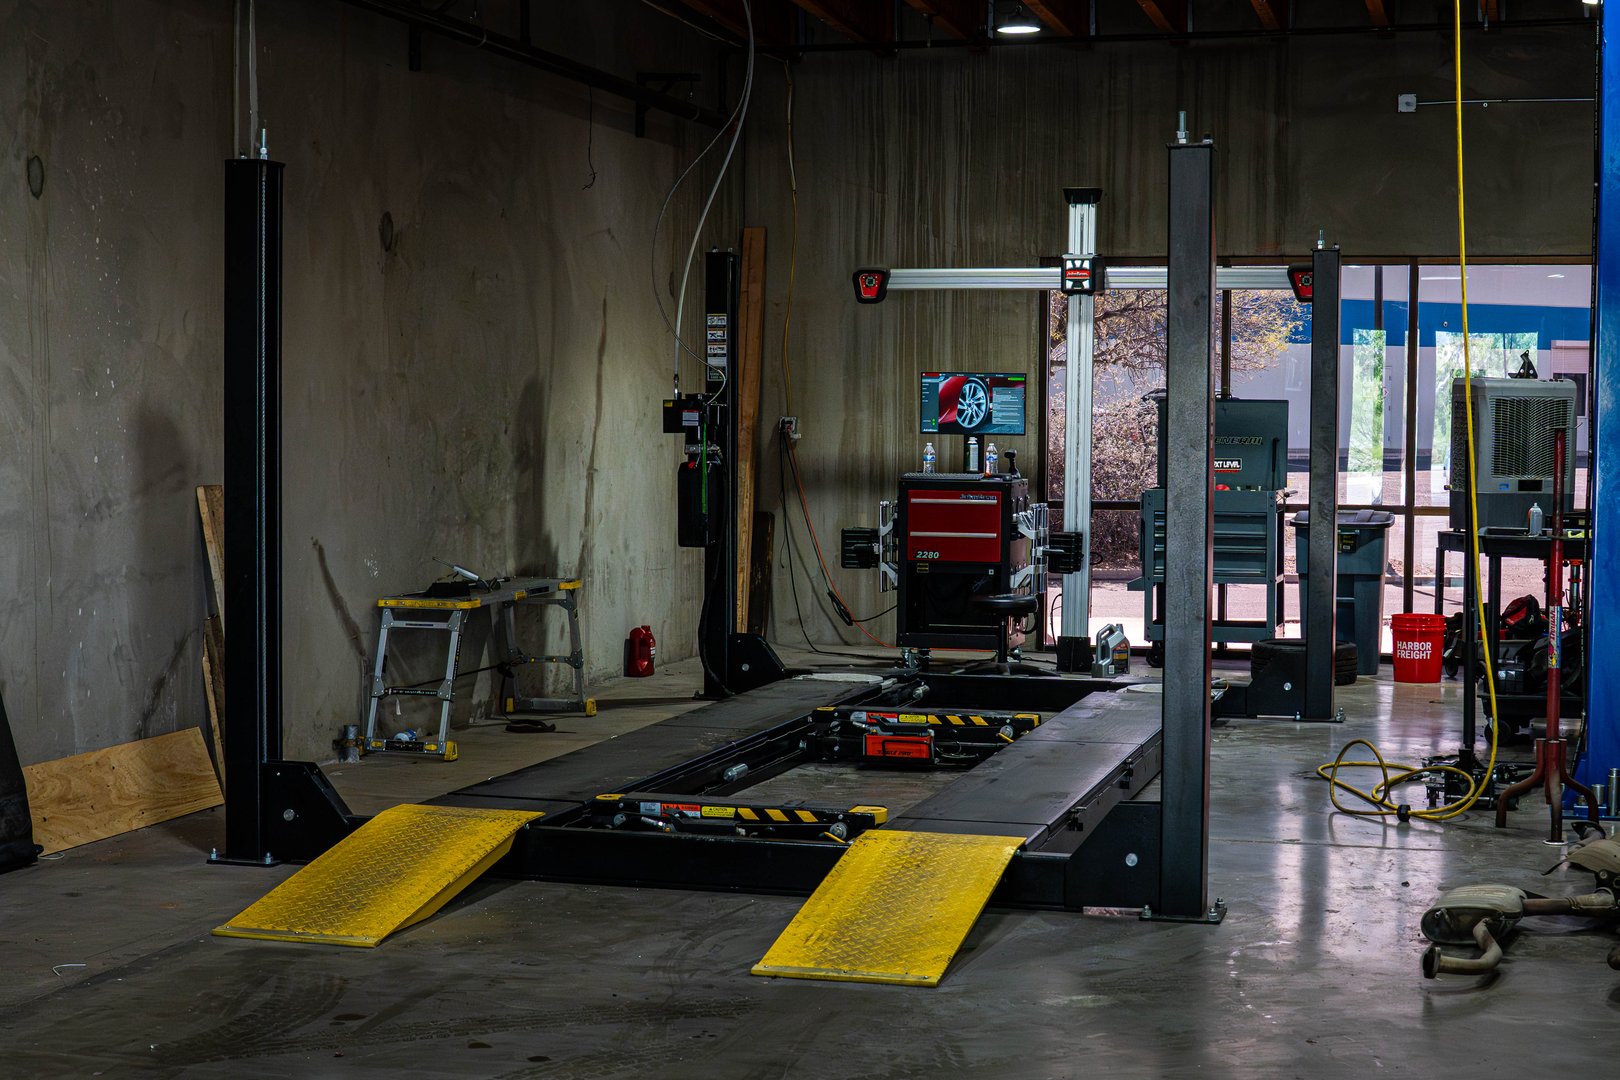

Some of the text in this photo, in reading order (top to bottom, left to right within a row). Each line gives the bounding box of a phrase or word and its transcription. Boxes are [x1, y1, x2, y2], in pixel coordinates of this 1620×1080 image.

[916, 551, 940, 559] 2280
[1397, 641, 1432, 651] HARBOR
[1397, 650, 1432, 660] FREIGHT
